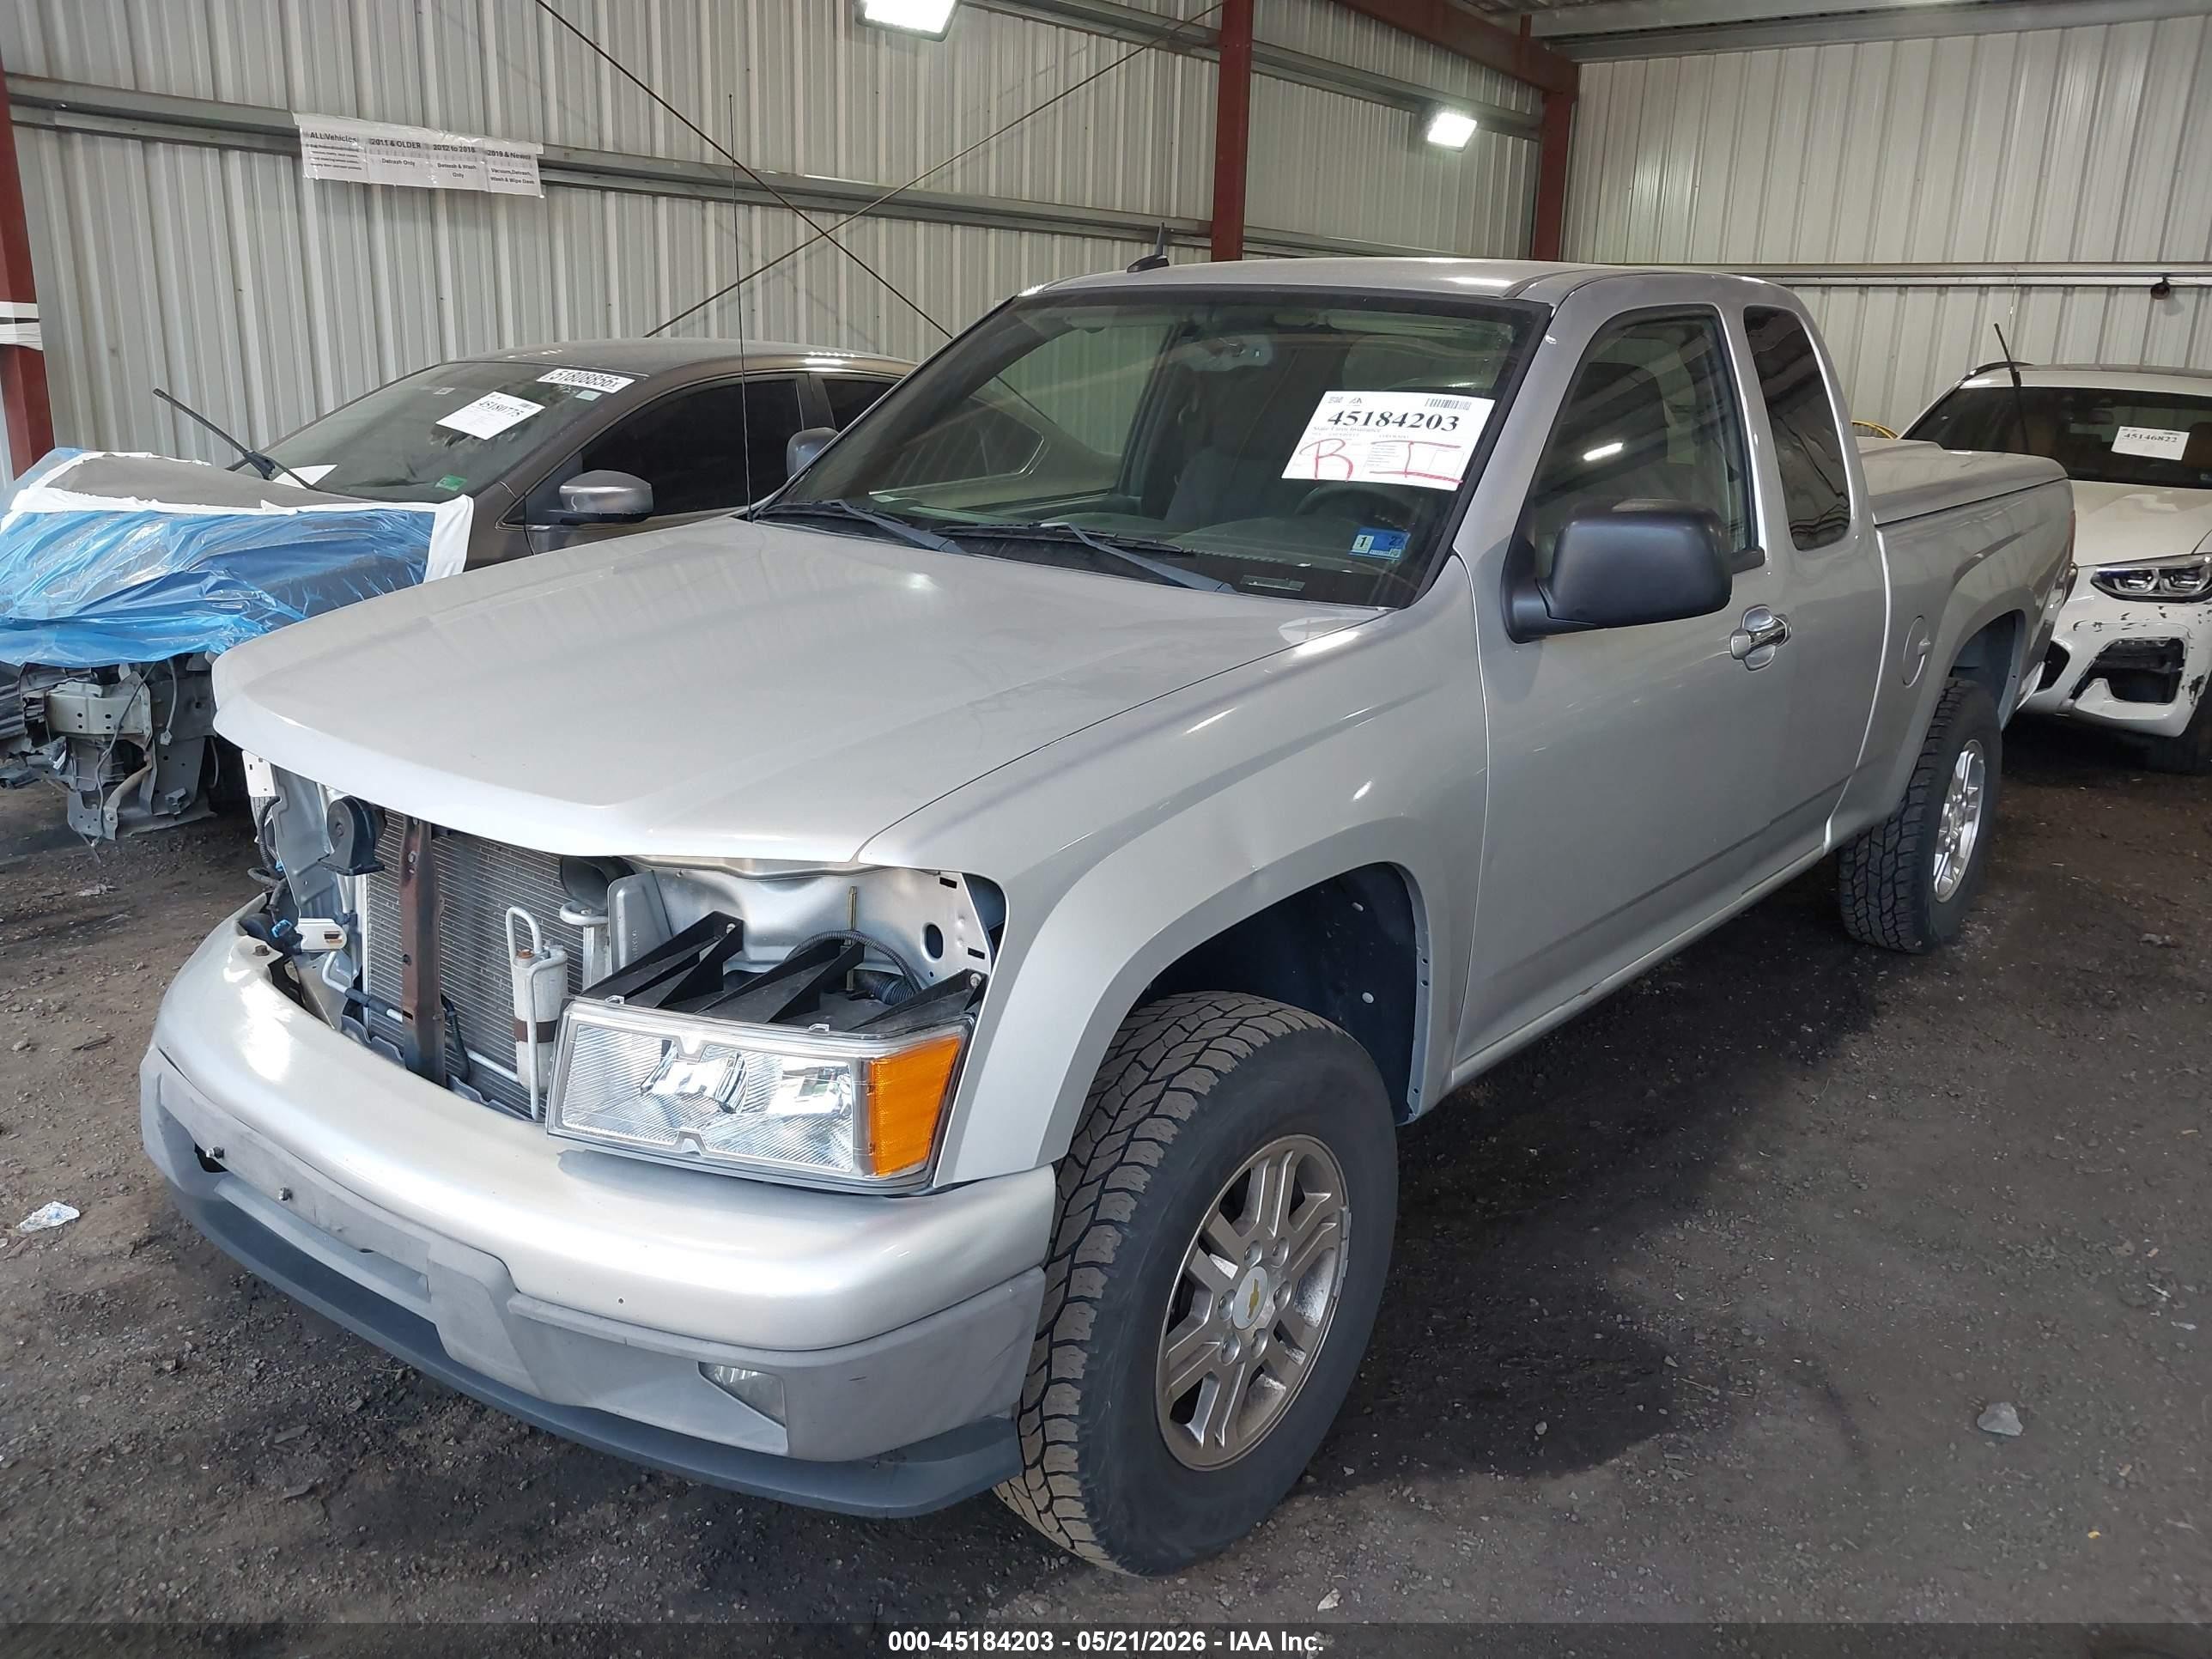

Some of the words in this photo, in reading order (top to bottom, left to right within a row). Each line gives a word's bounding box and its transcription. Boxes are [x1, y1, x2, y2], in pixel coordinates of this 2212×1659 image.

[325, 133, 357, 143] Vehicles
[397, 140, 421, 149] OLDER
[1328, 410, 1460, 432] 45184203
[1359, 537, 1368, 548] 1
